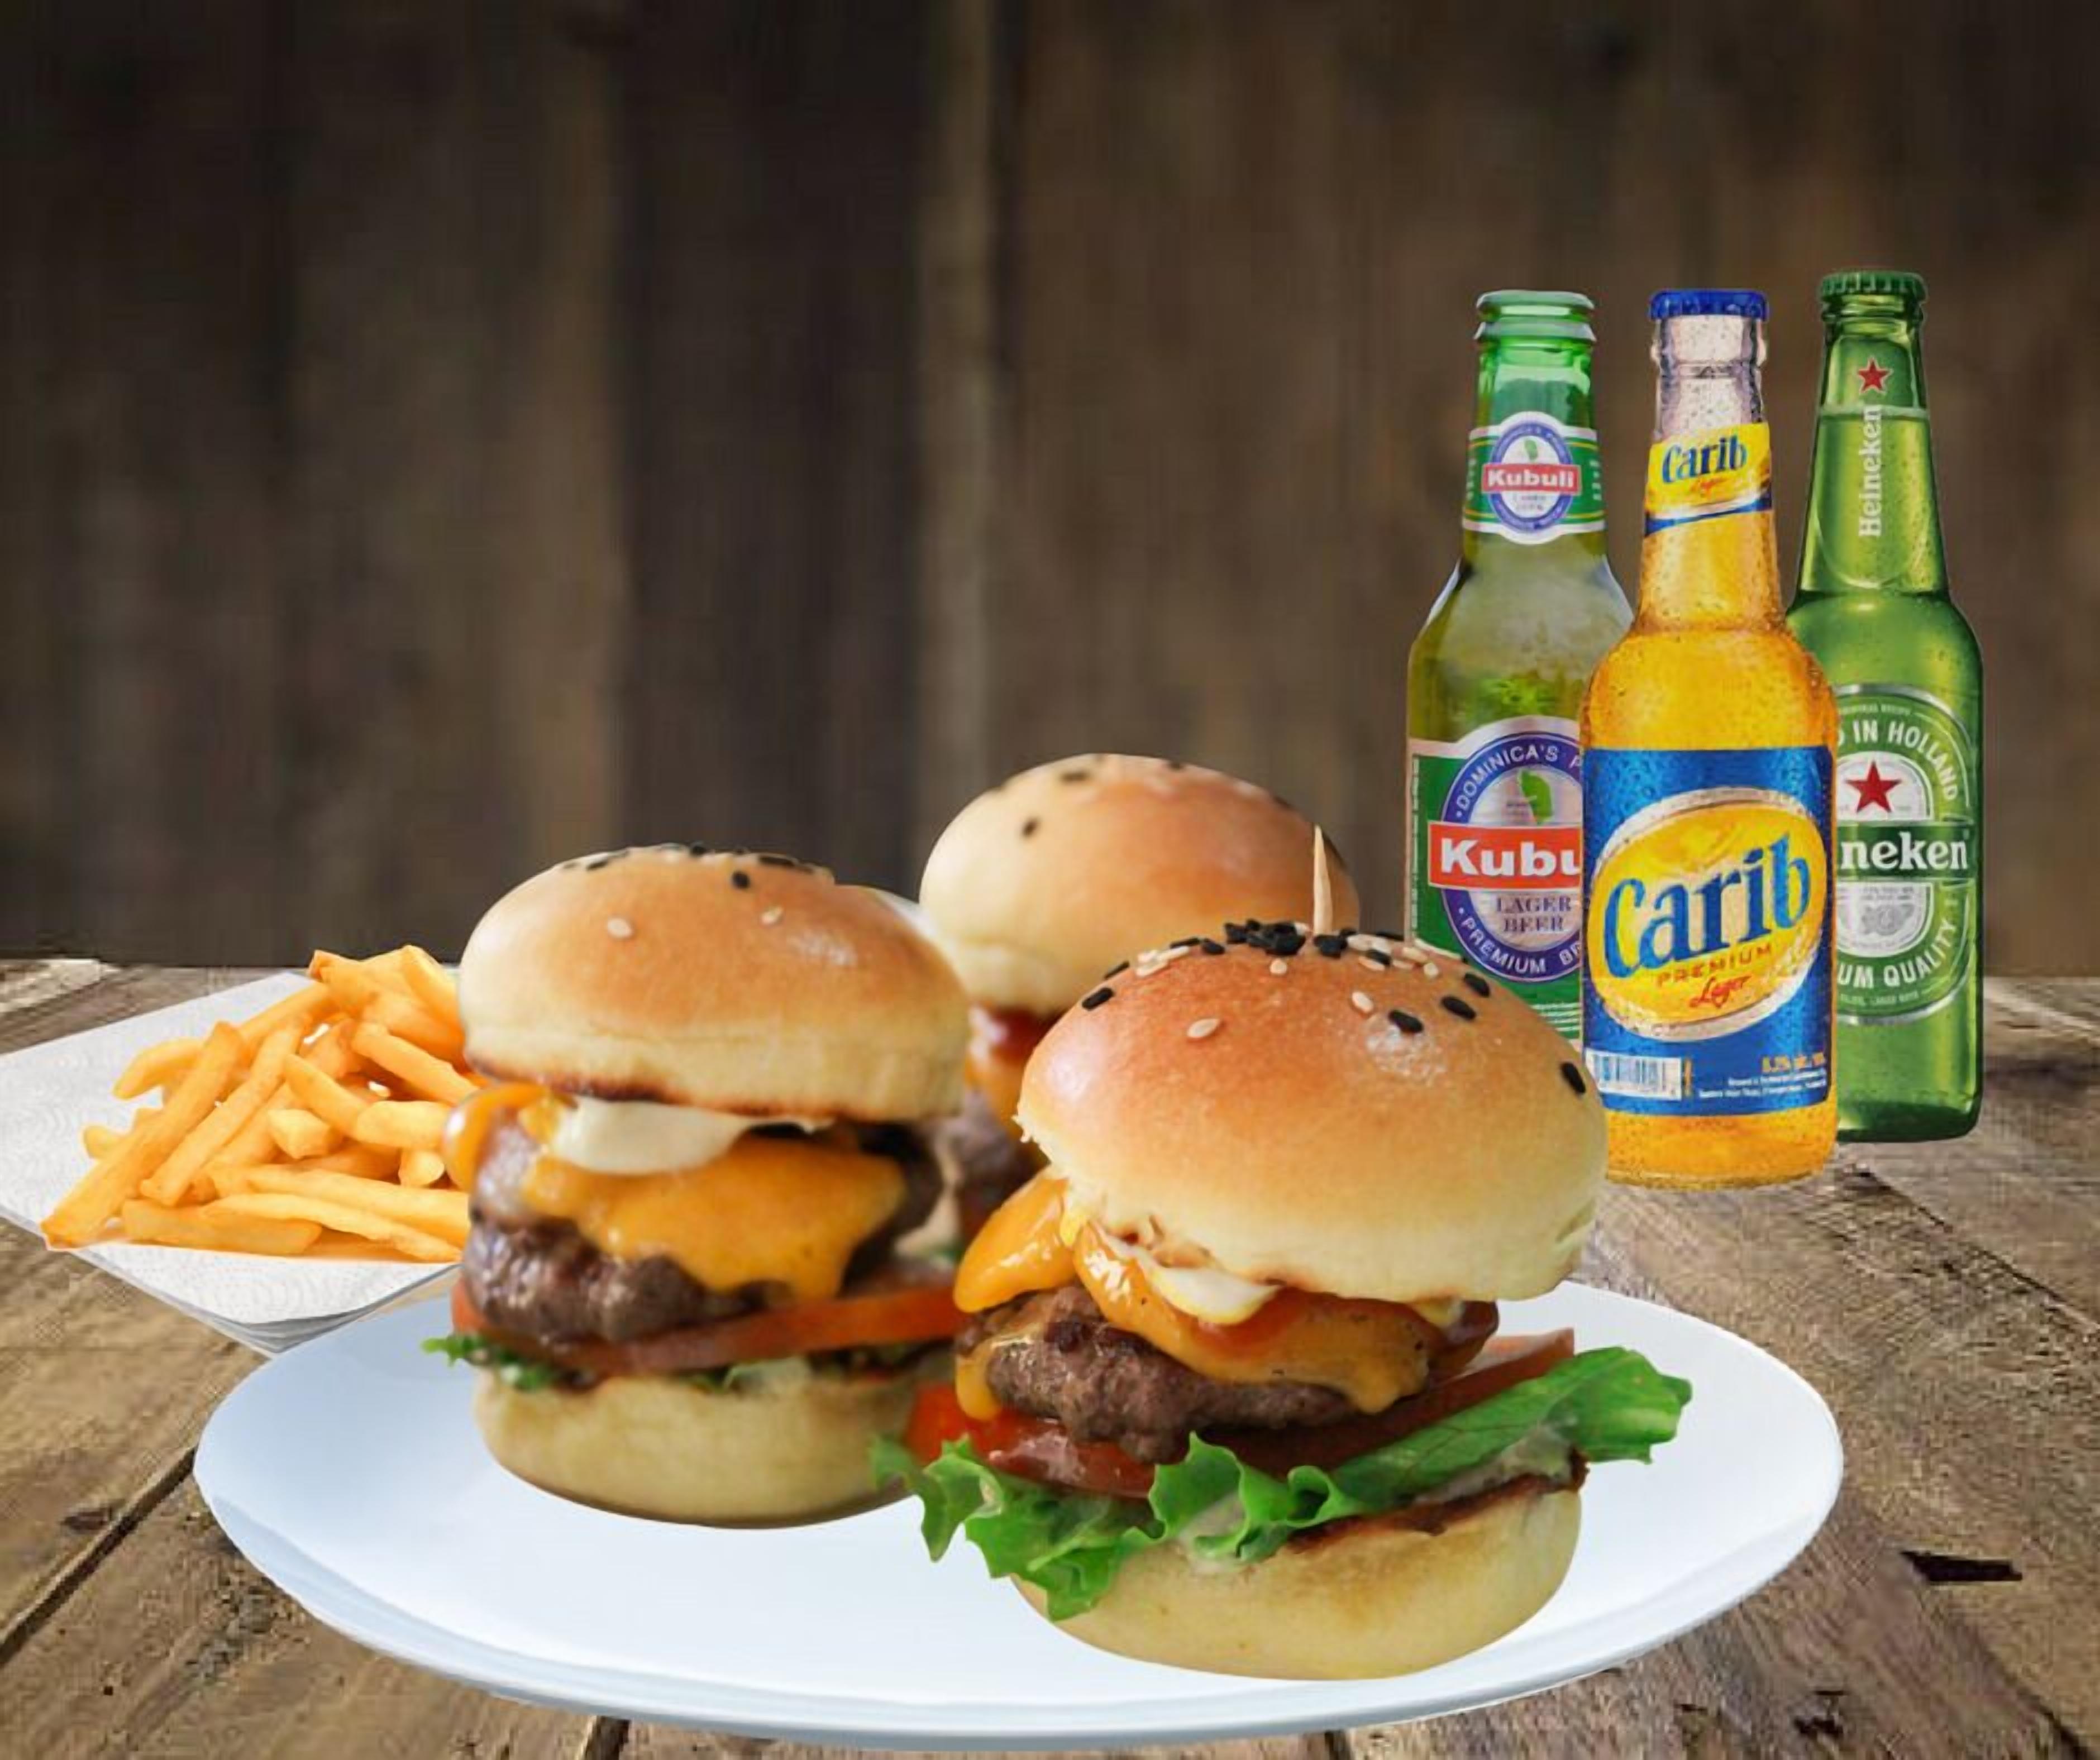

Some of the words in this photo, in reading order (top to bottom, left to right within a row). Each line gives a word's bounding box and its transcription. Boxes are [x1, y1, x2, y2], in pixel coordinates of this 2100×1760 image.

[1487, 468, 1574, 488] Kubuli
[1662, 434, 1748, 485] Carib
[1858, 404, 1882, 537] Heineken
[1455, 744, 1560, 811] DOMINICA'S
[1853, 719, 1878, 744] IN
[1887, 720, 1958, 801] HOLLAND
[1440, 837, 1582, 877] Kubu
[1840, 831, 1969, 870] neken
[1496, 896, 1571, 912] LAGER
[1504, 915, 1563, 932] BEER
[1603, 833, 1811, 979] Carib
[1461, 917, 1547, 974] PREMIUM
[1657, 941, 1771, 988] PREMIUM
[1883, 918, 1956, 987] QUALITY
